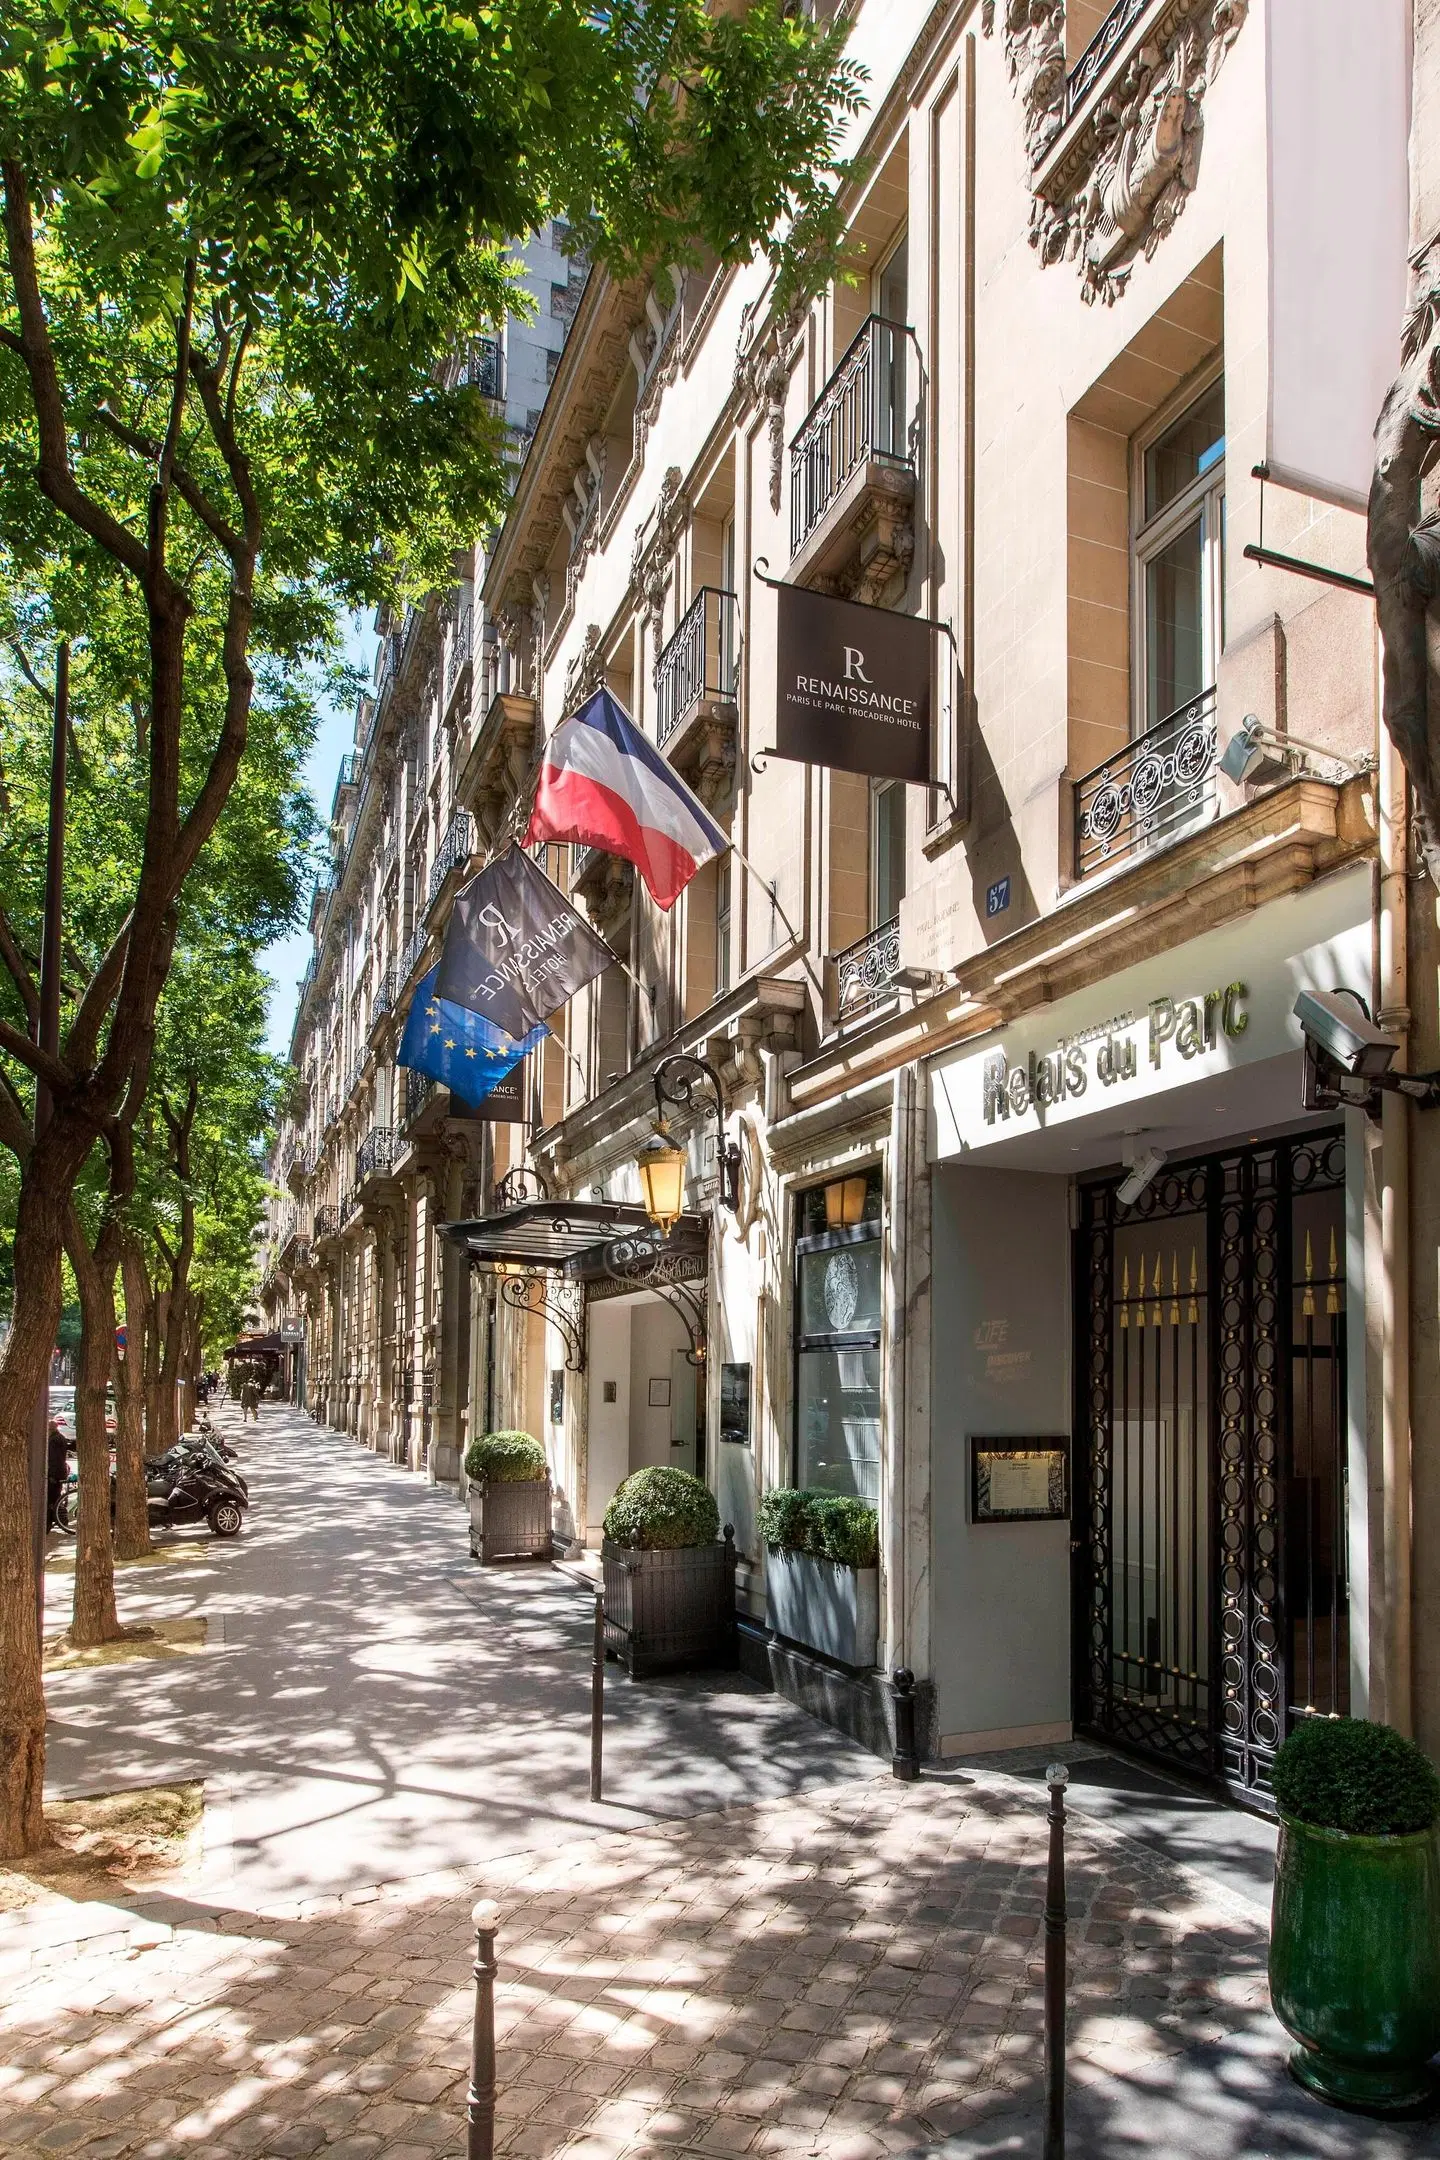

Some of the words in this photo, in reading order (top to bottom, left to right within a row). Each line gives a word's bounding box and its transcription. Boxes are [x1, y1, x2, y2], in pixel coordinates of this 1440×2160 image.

[843, 646, 873, 683] R
[786, 693, 810, 706] PARIS
[812, 699, 822, 708] LE
[825, 701, 846, 713] PARC
[848, 707, 895, 724] TROCADERO
[897, 717, 922, 730] HOTEL
[796, 675, 913, 715] RENAISSANCE
[989, 881, 1009, 913] 57
[983, 1048, 1087, 1124] Relais
[1097, 1033, 1137, 1087] du
[1148, 981, 1249, 1071] Parc
